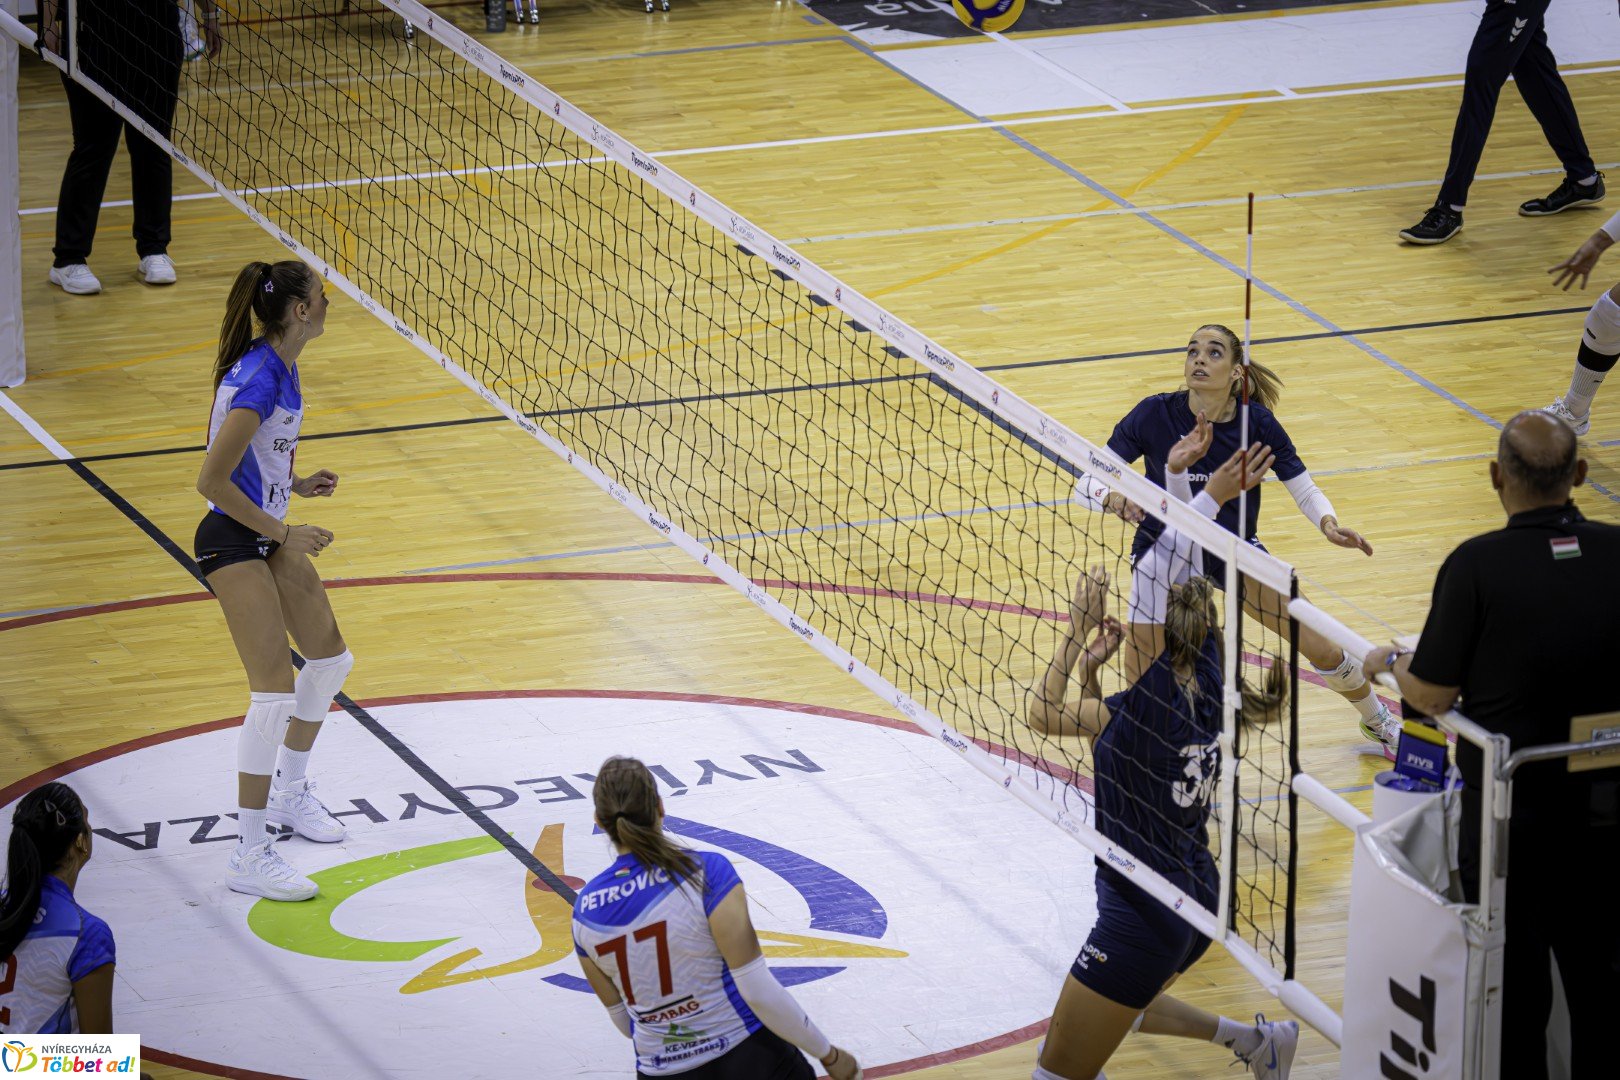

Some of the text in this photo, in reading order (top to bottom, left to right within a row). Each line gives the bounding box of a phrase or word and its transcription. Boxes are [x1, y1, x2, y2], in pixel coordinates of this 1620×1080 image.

[1407, 752, 1434, 770] FIVB
[92, 749, 825, 851] NYÍEGYHZA
[595, 920, 673, 1005] 77
[641, 1000, 700, 1024] RABAG
